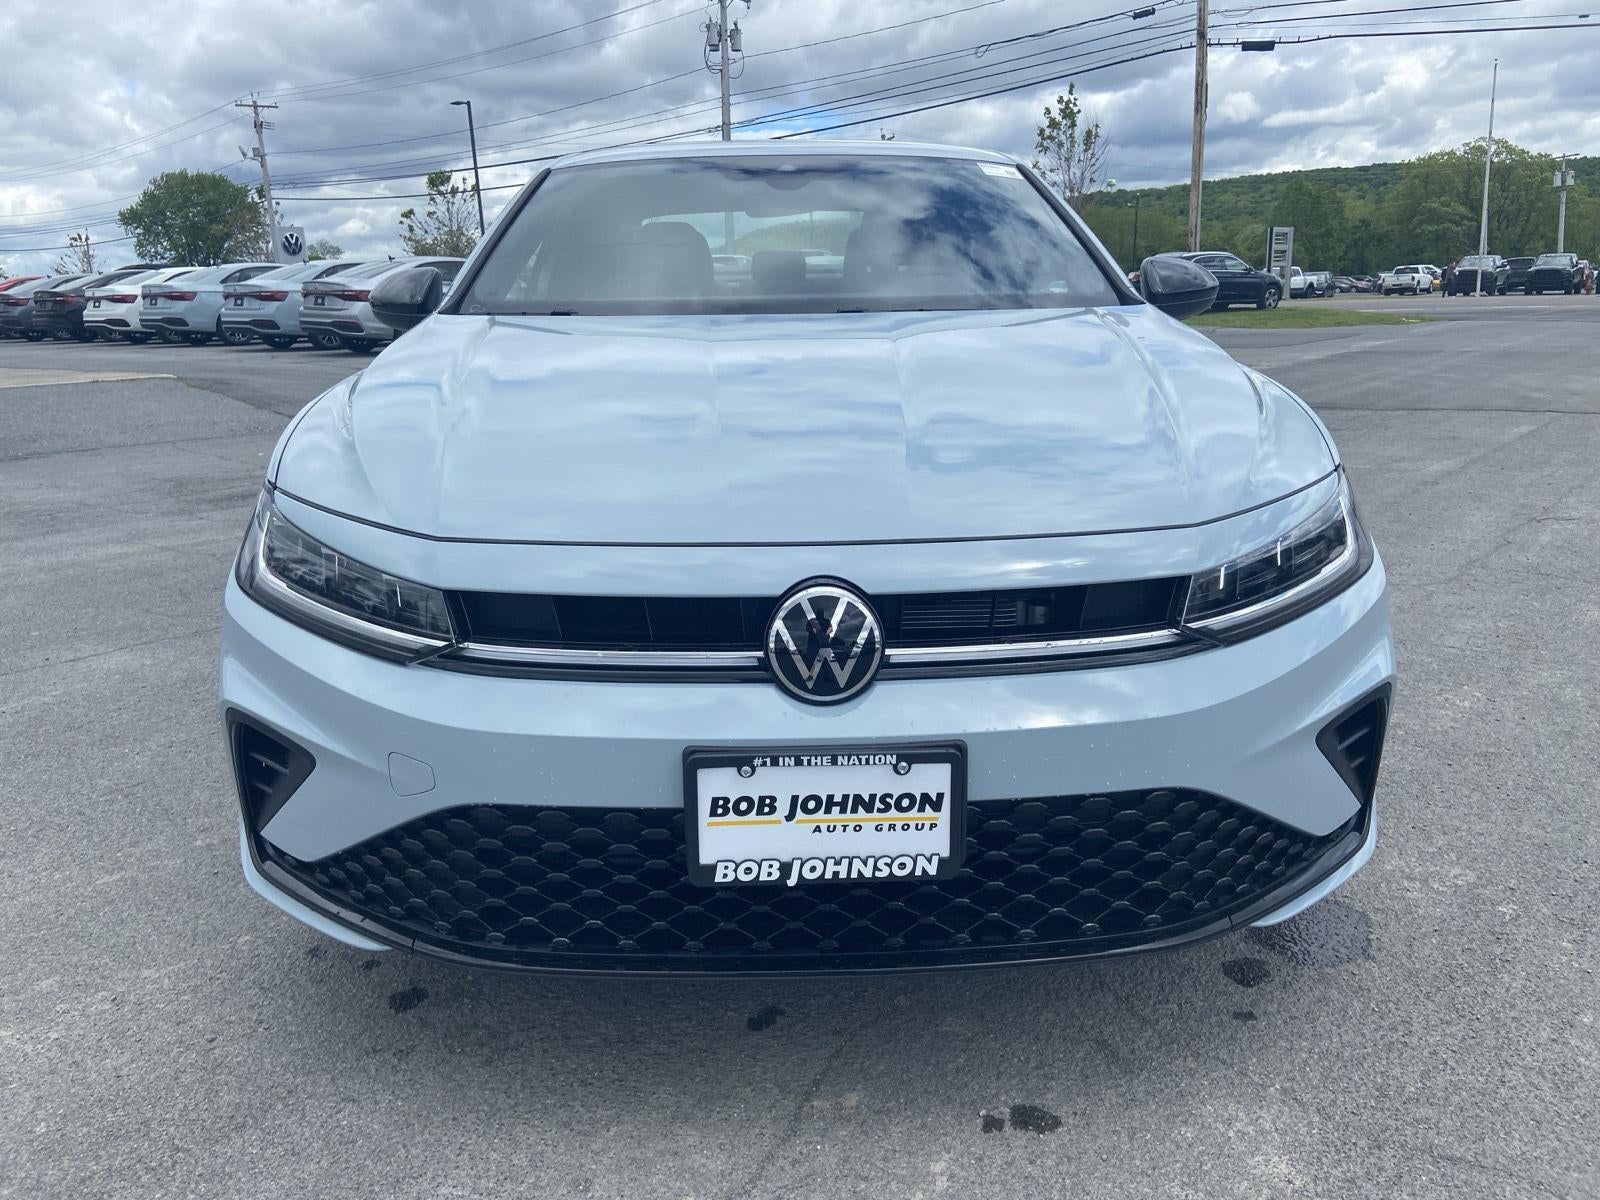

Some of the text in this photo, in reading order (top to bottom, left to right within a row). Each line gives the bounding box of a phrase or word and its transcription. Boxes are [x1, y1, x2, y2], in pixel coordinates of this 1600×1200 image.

[772, 590, 877, 697] VW
[753, 754, 897, 767] #1 IN THE NATION
[708, 792, 945, 823] BOB JOHNSON
[812, 822, 938, 834] AUTO GROUP
[714, 854, 940, 887] BOB JOHNSON
